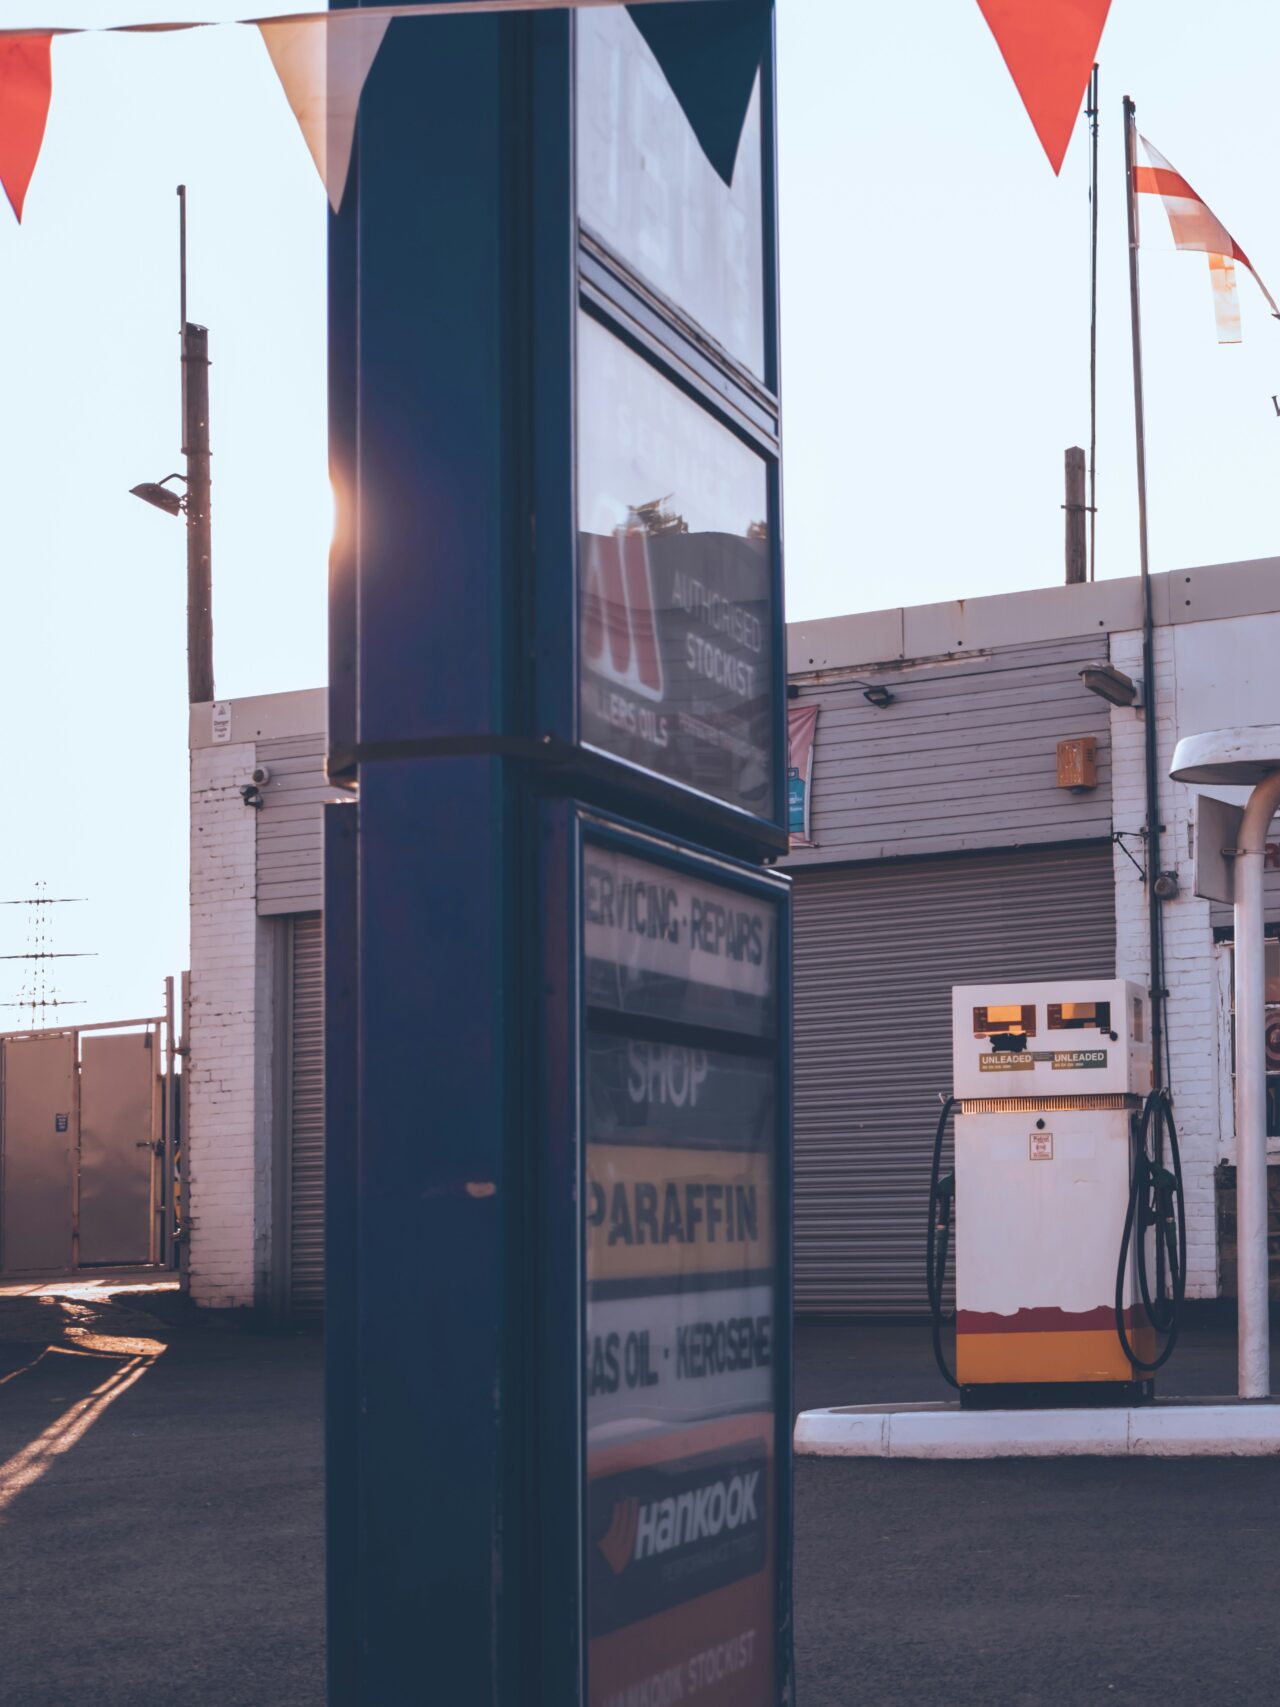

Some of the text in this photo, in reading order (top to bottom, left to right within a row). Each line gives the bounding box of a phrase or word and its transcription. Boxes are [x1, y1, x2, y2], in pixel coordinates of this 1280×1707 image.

[672, 569, 761, 653] AUTHORISED
[686, 631, 755, 701] STOCKIST
[639, 706, 668, 749] OILS
[690, 896, 763, 967] REPAIRS
[628, 1039, 707, 1107] SHOP
[981, 1054, 1032, 1064] UNLEADED
[1054, 1052, 1105, 1062] UNLEADED
[587, 1180, 759, 1246] PARAFFIN
[586, 1315, 771, 1397] AS OIL KEROSENE
[687, 1627, 759, 1694] STOCKIST
